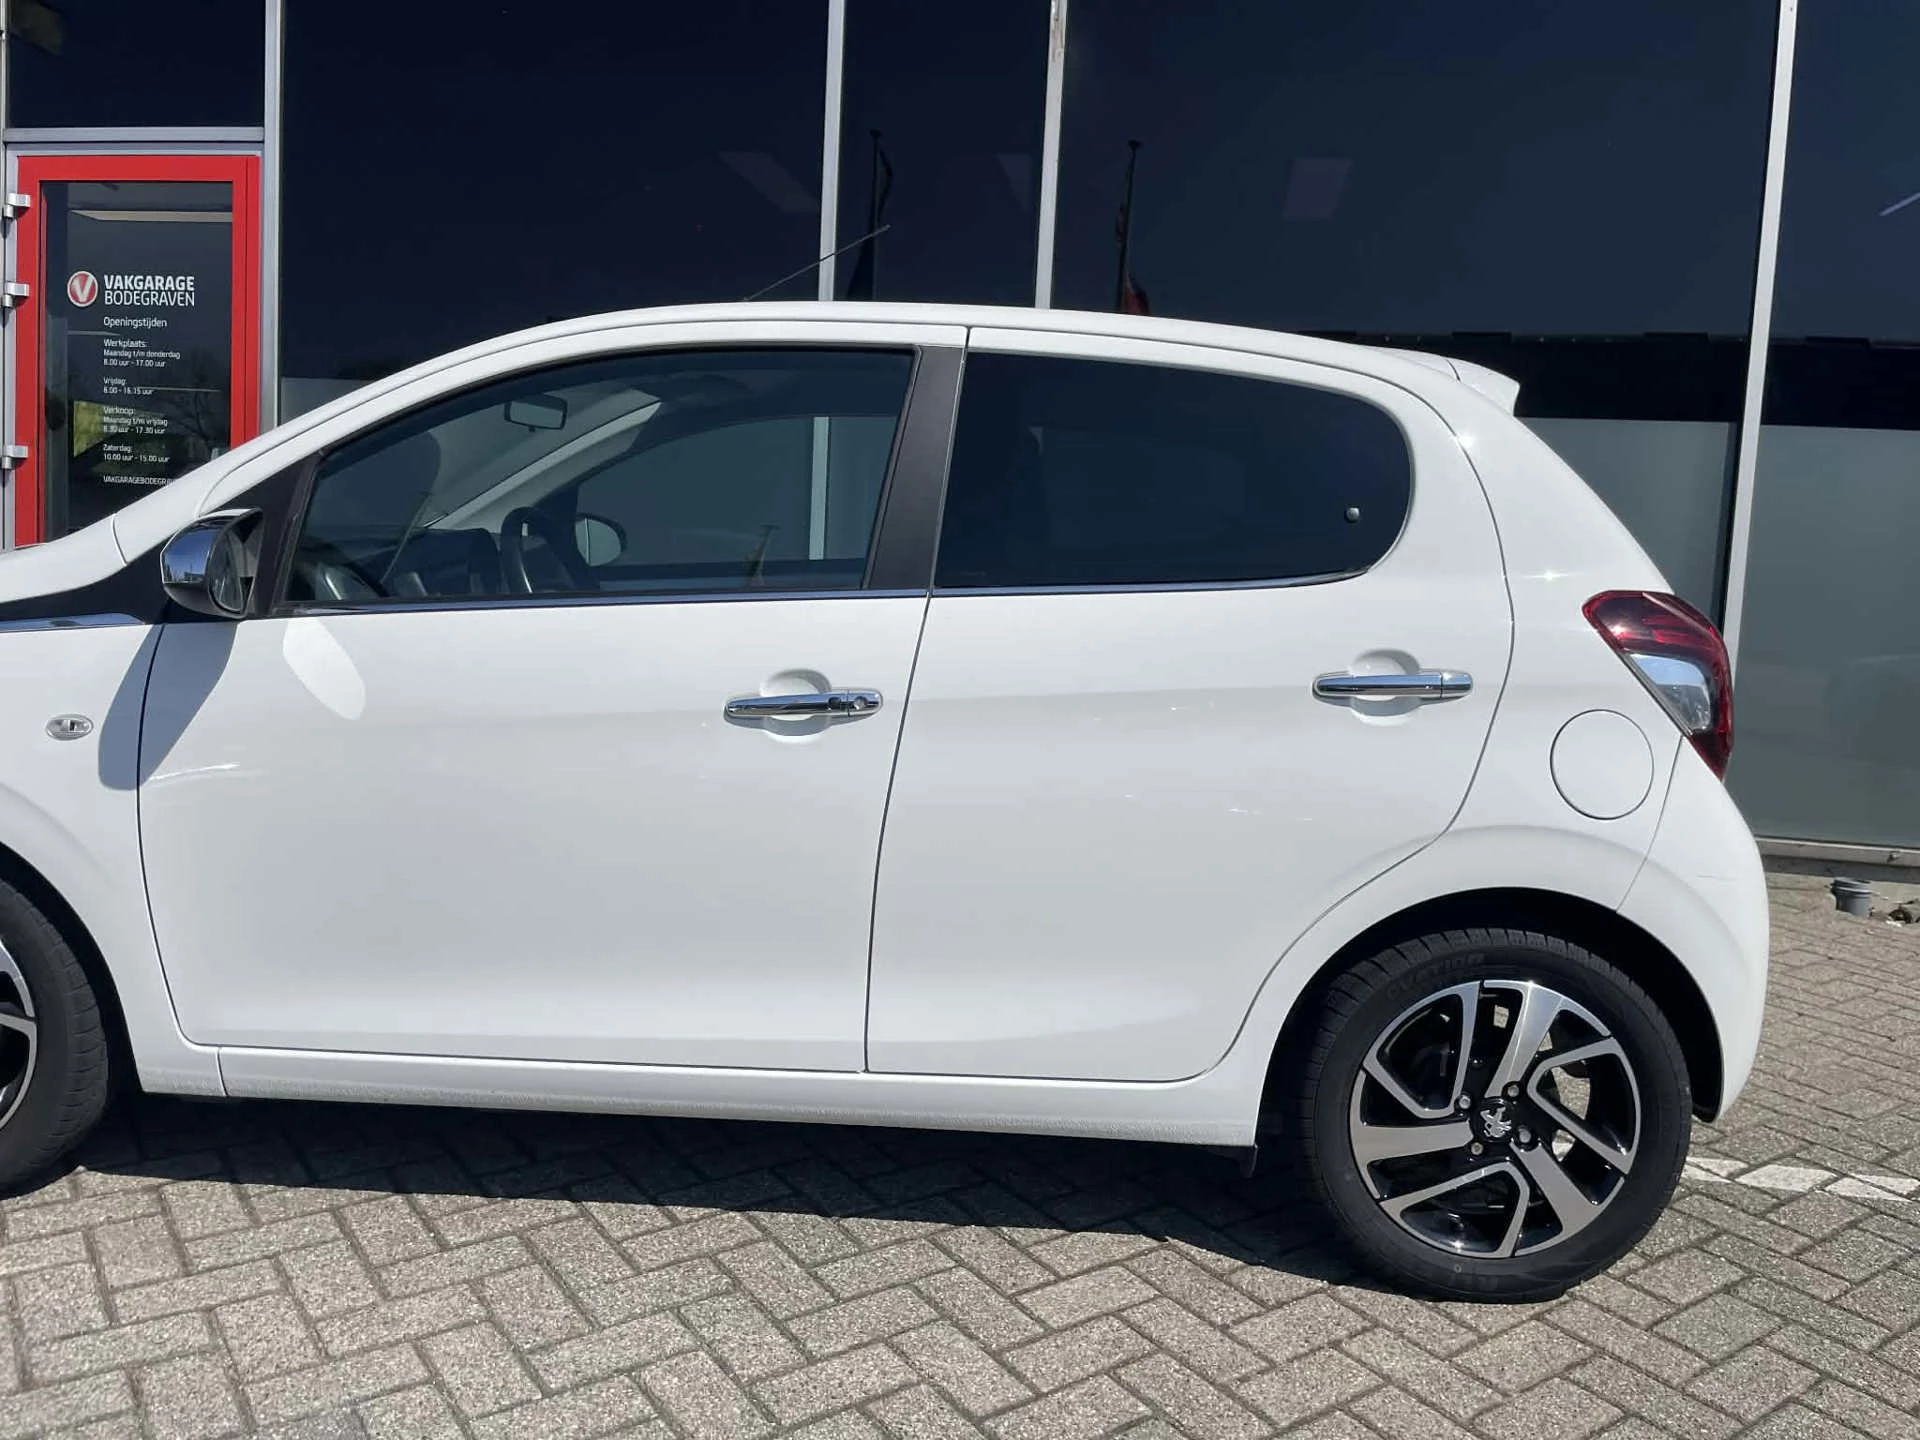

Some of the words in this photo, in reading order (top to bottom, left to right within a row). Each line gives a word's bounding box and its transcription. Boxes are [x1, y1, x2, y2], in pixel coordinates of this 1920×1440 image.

[104, 275, 195, 291] VAKGARAGE
[105, 291, 195, 306] BODEGRAVEN
[104, 317, 168, 329] Openingstijden
[104, 350, 132, 358] Maandag
[146, 350, 180, 359] donderdag
